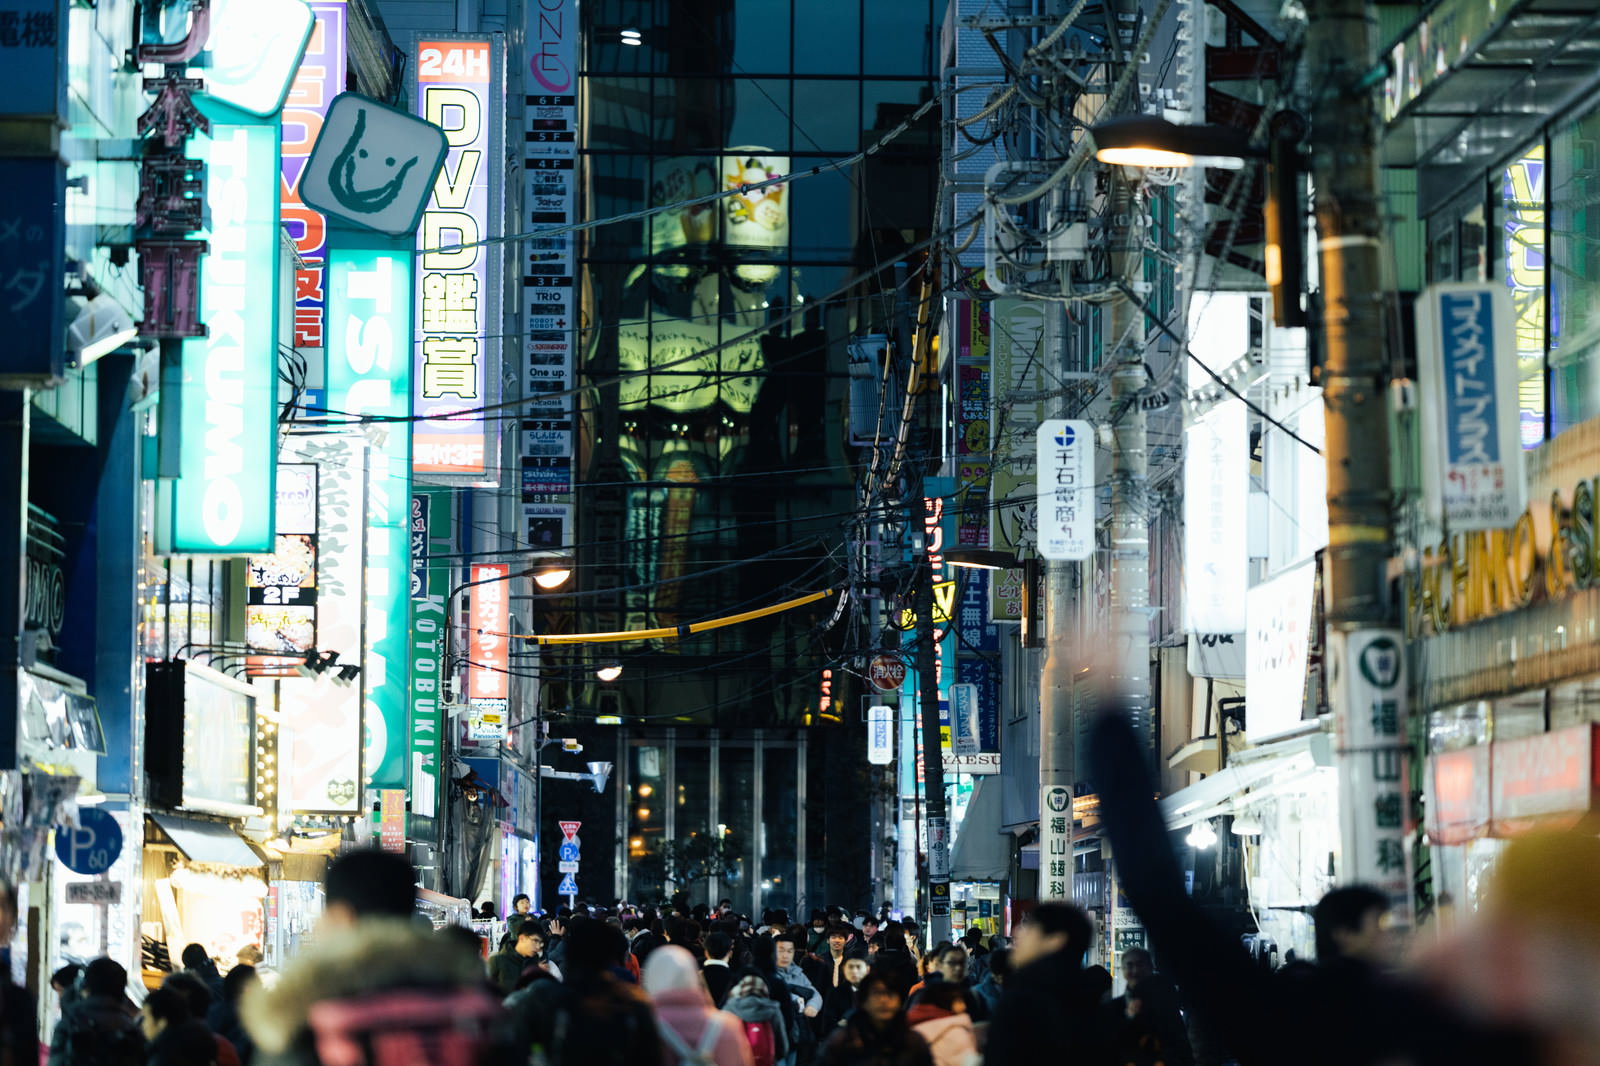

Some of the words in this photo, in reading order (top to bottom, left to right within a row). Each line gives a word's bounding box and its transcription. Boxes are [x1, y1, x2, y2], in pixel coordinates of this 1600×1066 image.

[419, 48, 489, 78] 24H
[202, 127, 249, 547] TSUKUMO
[529, 367, 549, 377] One
[263, 586, 301, 605] 2F
[873, 664, 904, 680] 消火栓
[941, 754, 1001, 766] YAESU
[70, 825, 97, 869] P
[1049, 817, 1066, 898] 福山歯科
[1118, 932, 1141, 940] 外神田
